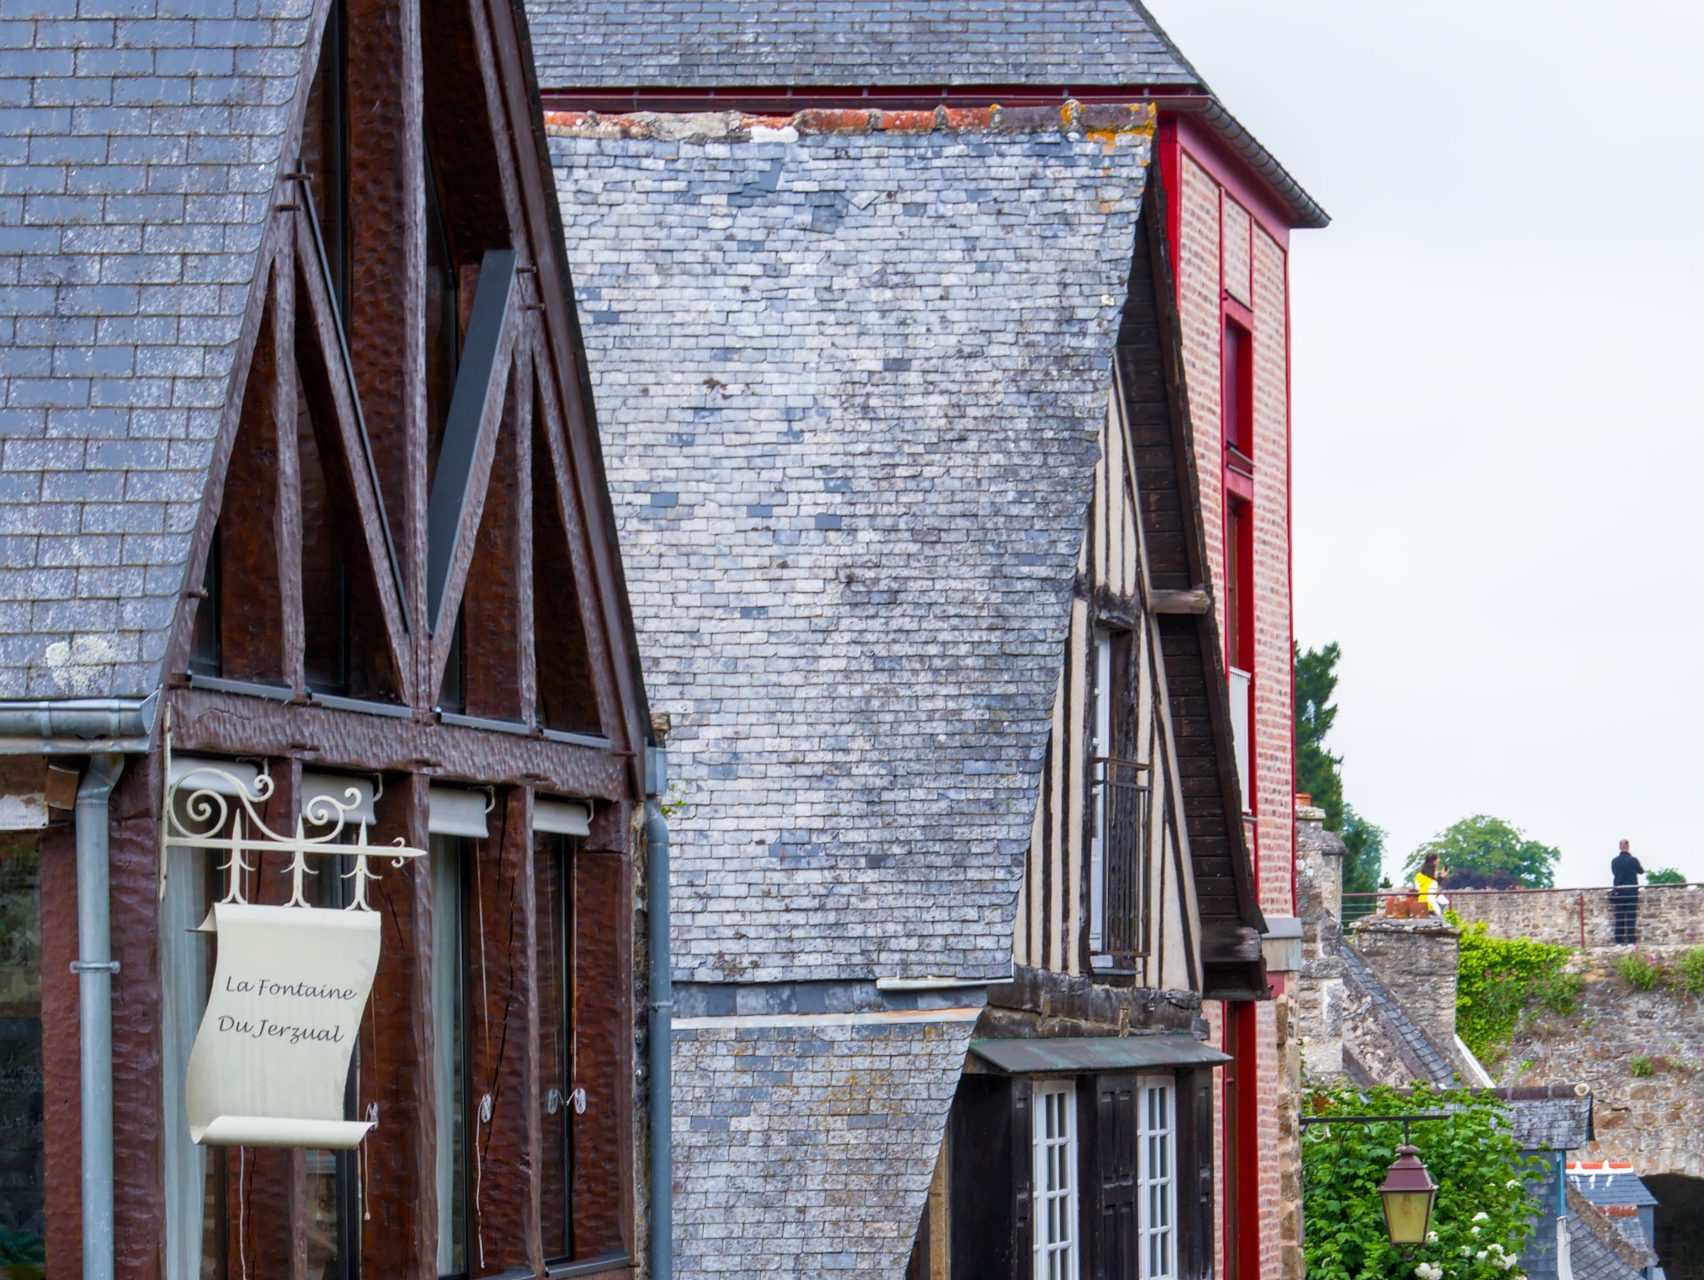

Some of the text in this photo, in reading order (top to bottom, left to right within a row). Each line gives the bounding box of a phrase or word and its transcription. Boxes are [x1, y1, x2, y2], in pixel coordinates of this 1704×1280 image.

[226, 976, 358, 1001] La Fontaine
[218, 1015, 344, 1044] Du Jerzual
